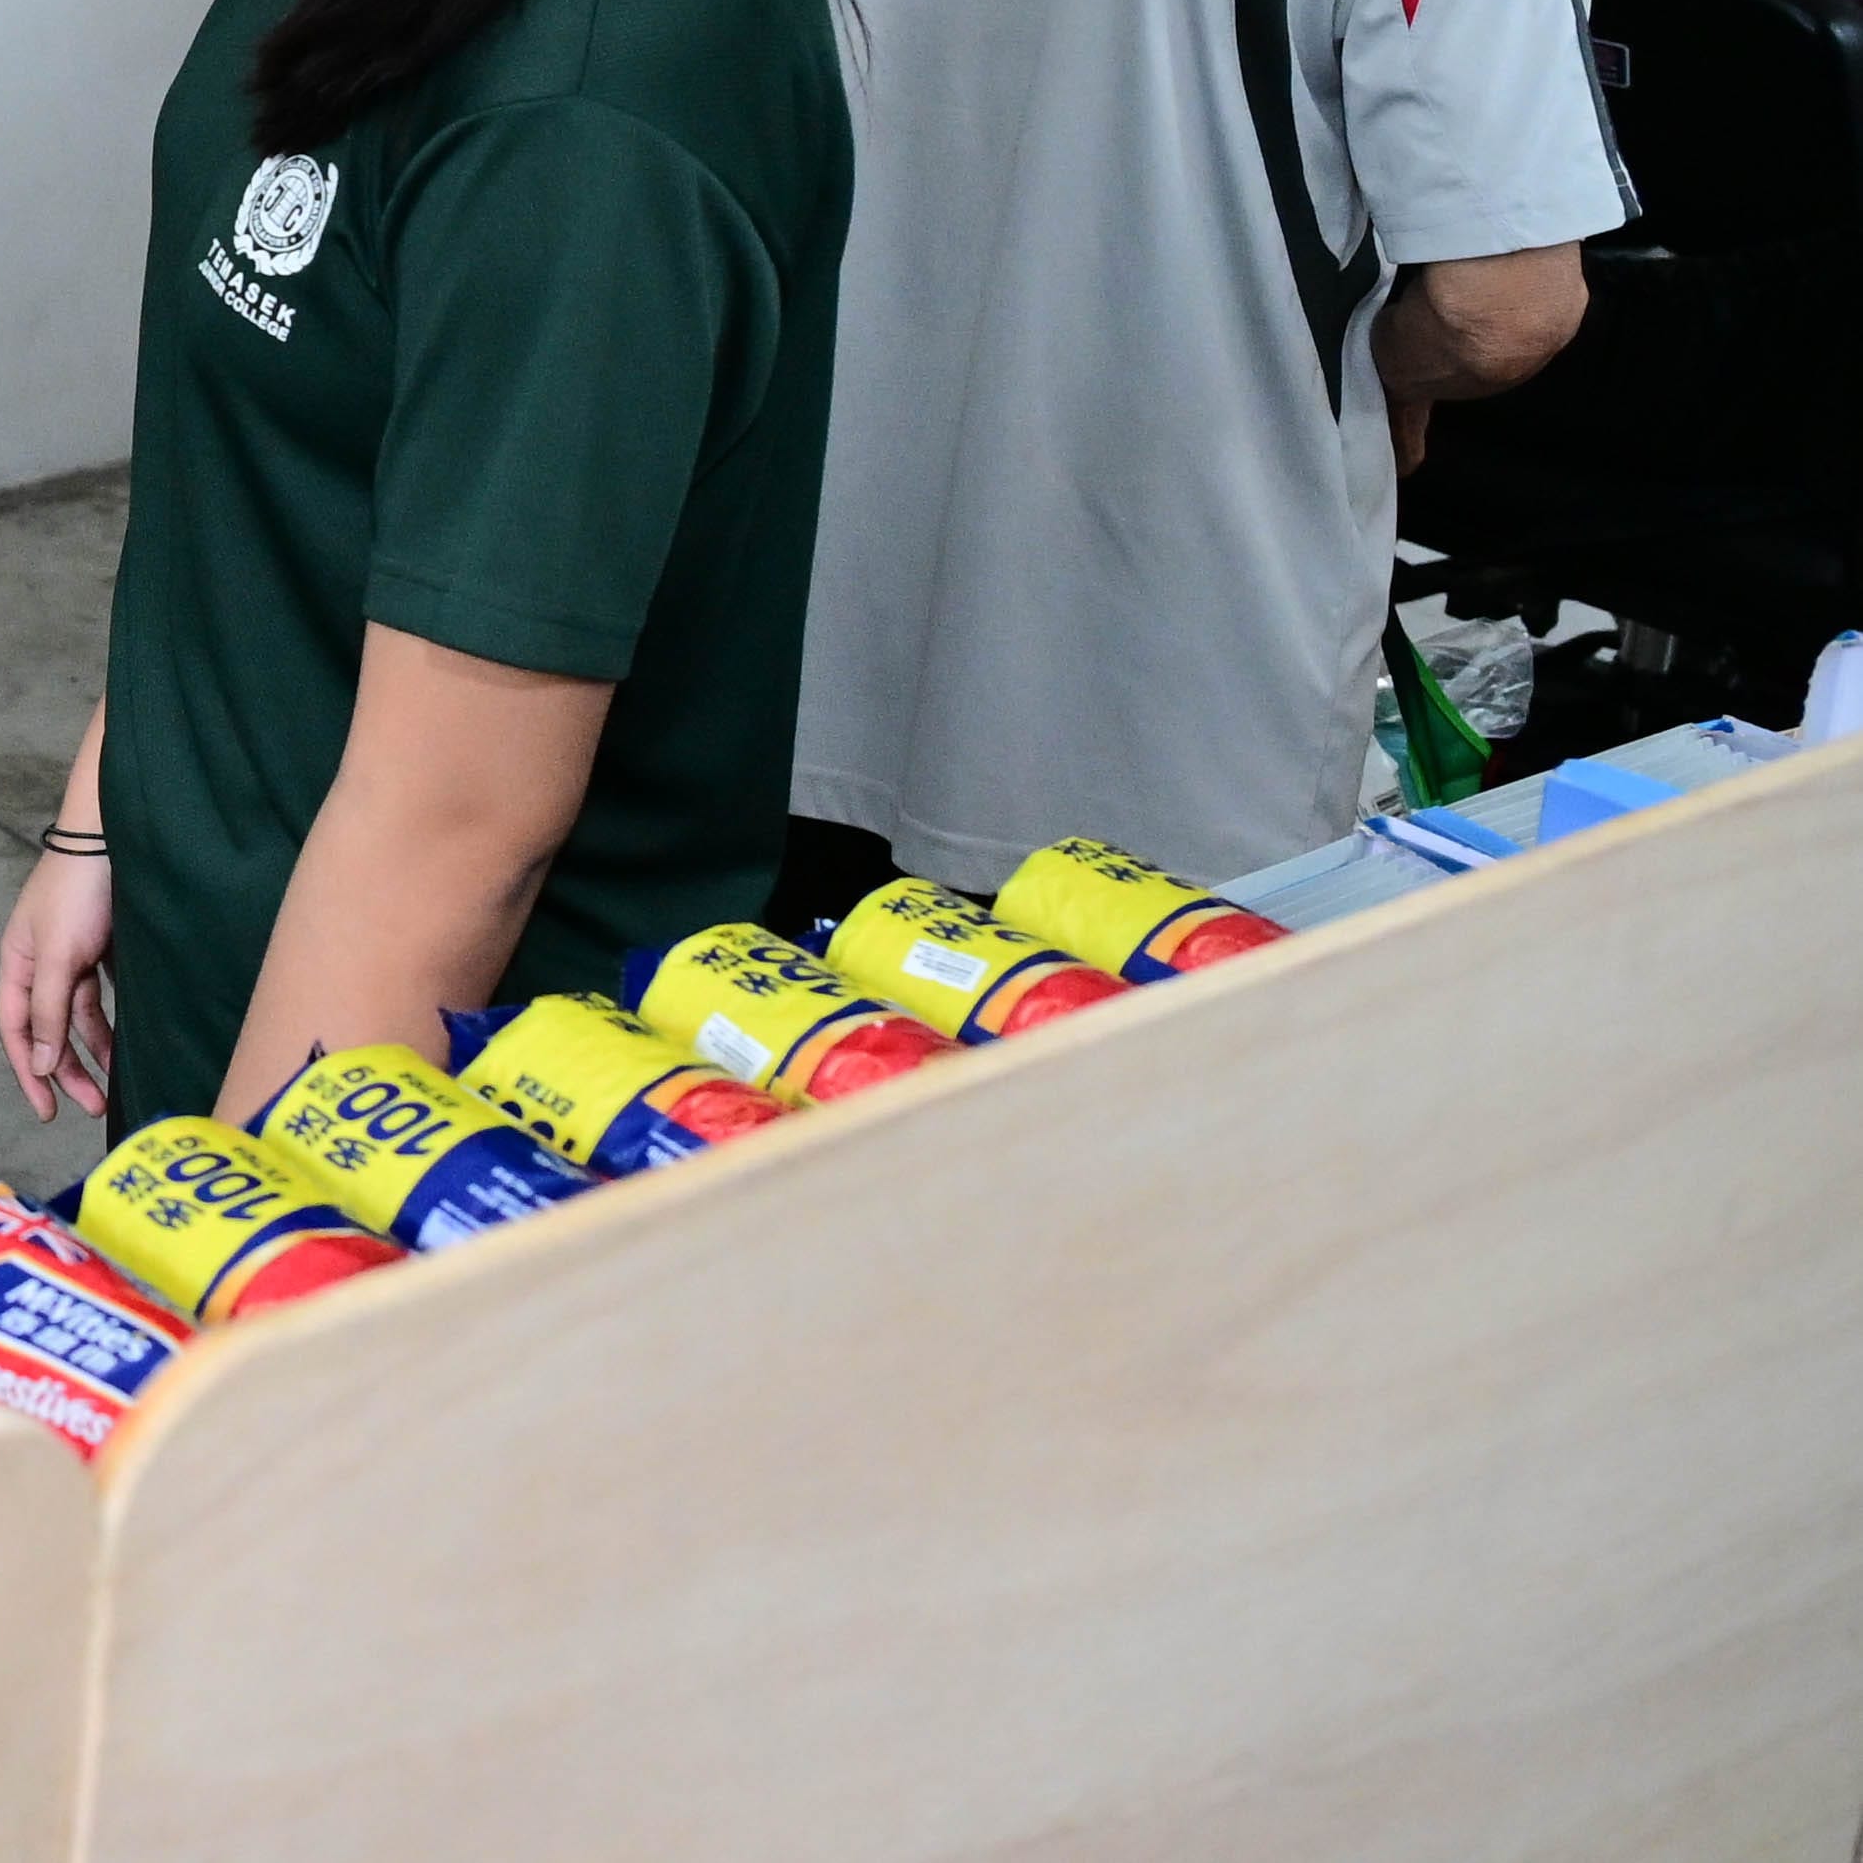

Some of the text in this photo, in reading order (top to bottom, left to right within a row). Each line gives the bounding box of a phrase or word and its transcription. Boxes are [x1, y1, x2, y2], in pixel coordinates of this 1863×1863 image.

[207, 238, 296, 326] TEMASEK
[224, 291, 290, 342] COLLEGE
[518, 1071, 577, 1116] EXTRA
